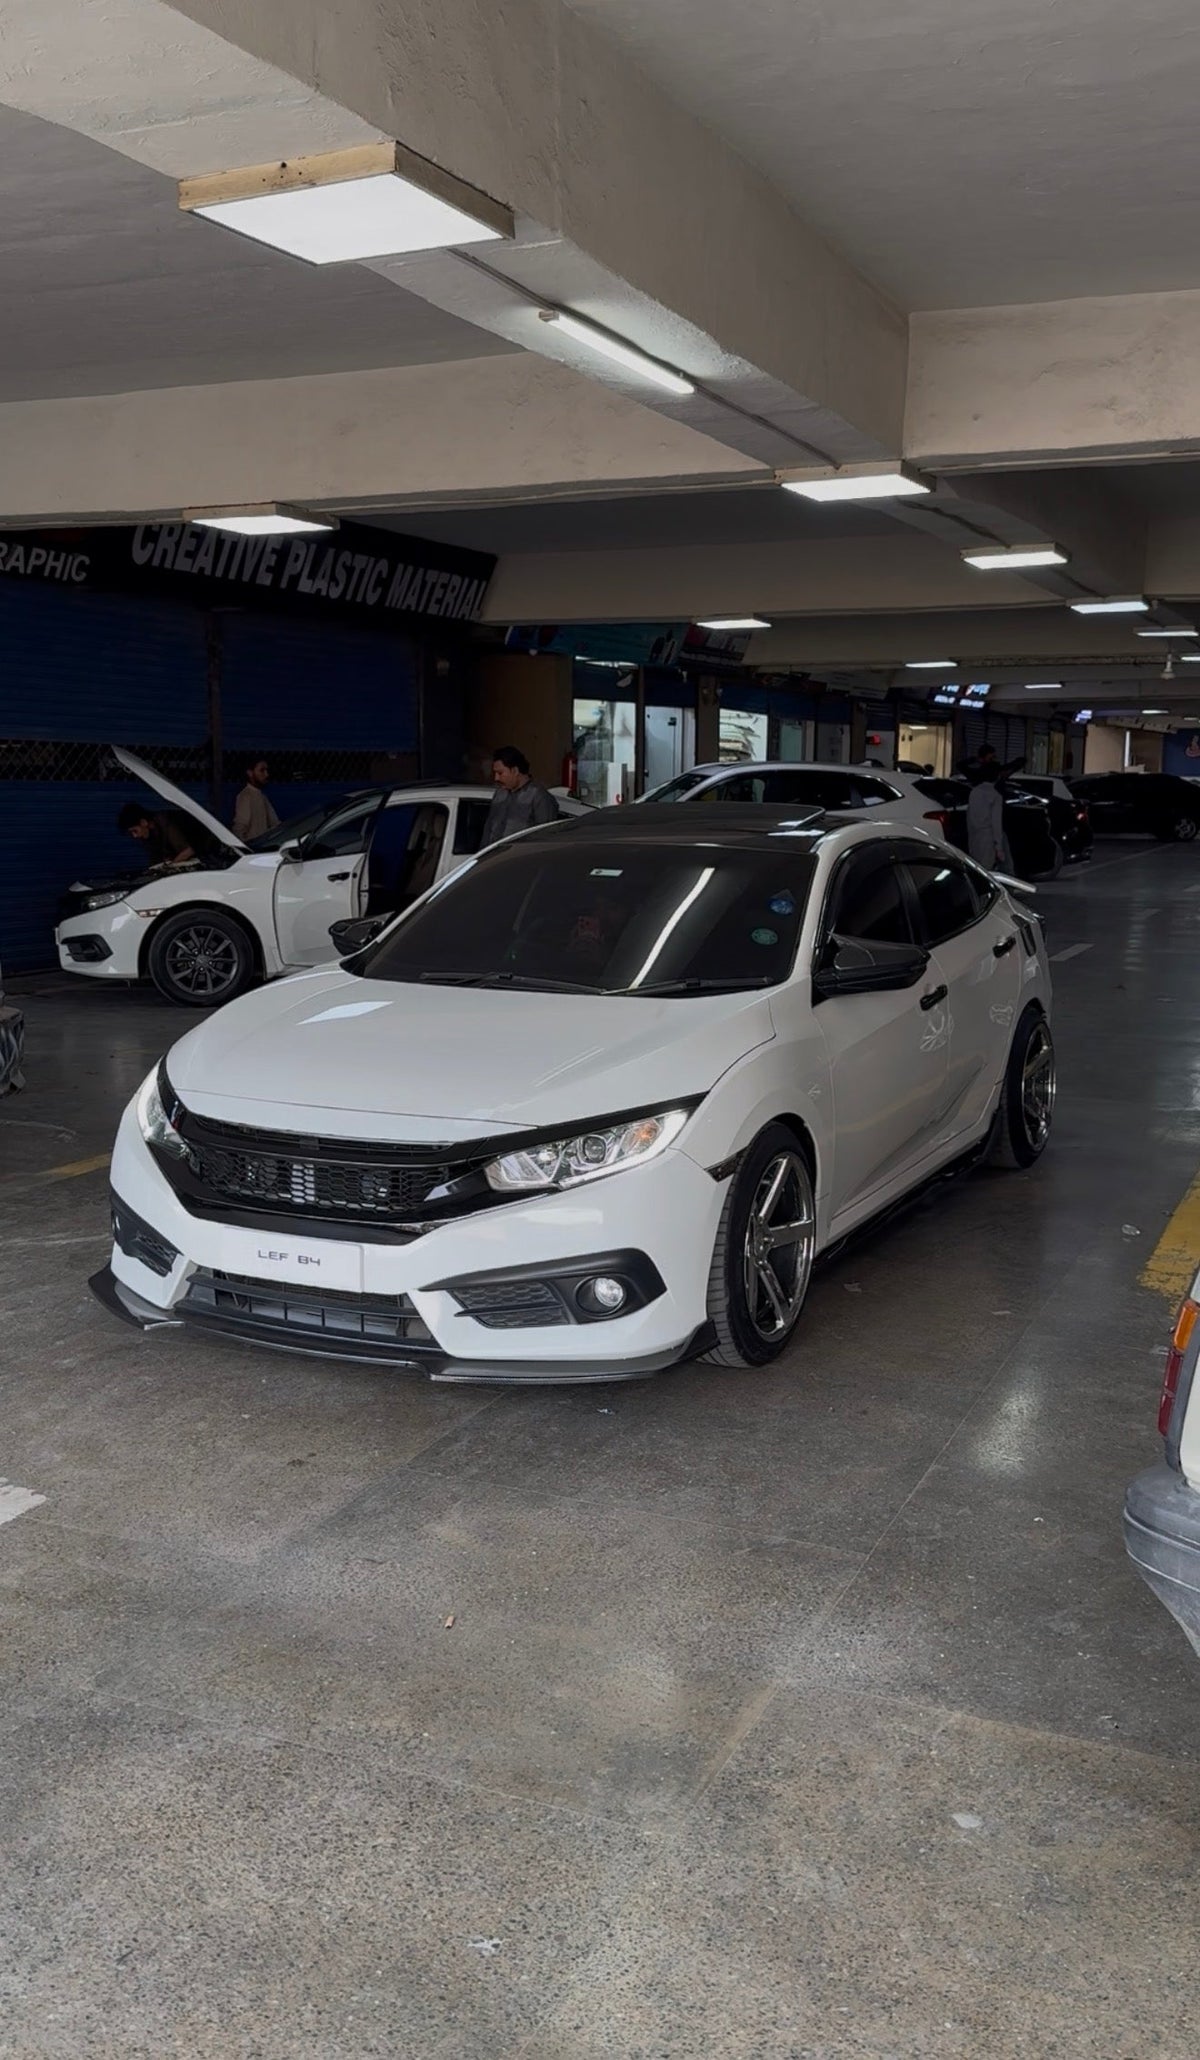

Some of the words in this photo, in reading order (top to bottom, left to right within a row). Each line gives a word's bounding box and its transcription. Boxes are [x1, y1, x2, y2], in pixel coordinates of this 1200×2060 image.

[131, 524, 284, 586] CREATIVE
[280, 539, 389, 606] PLASTIC
[257, 1249, 289, 1261] LEF
